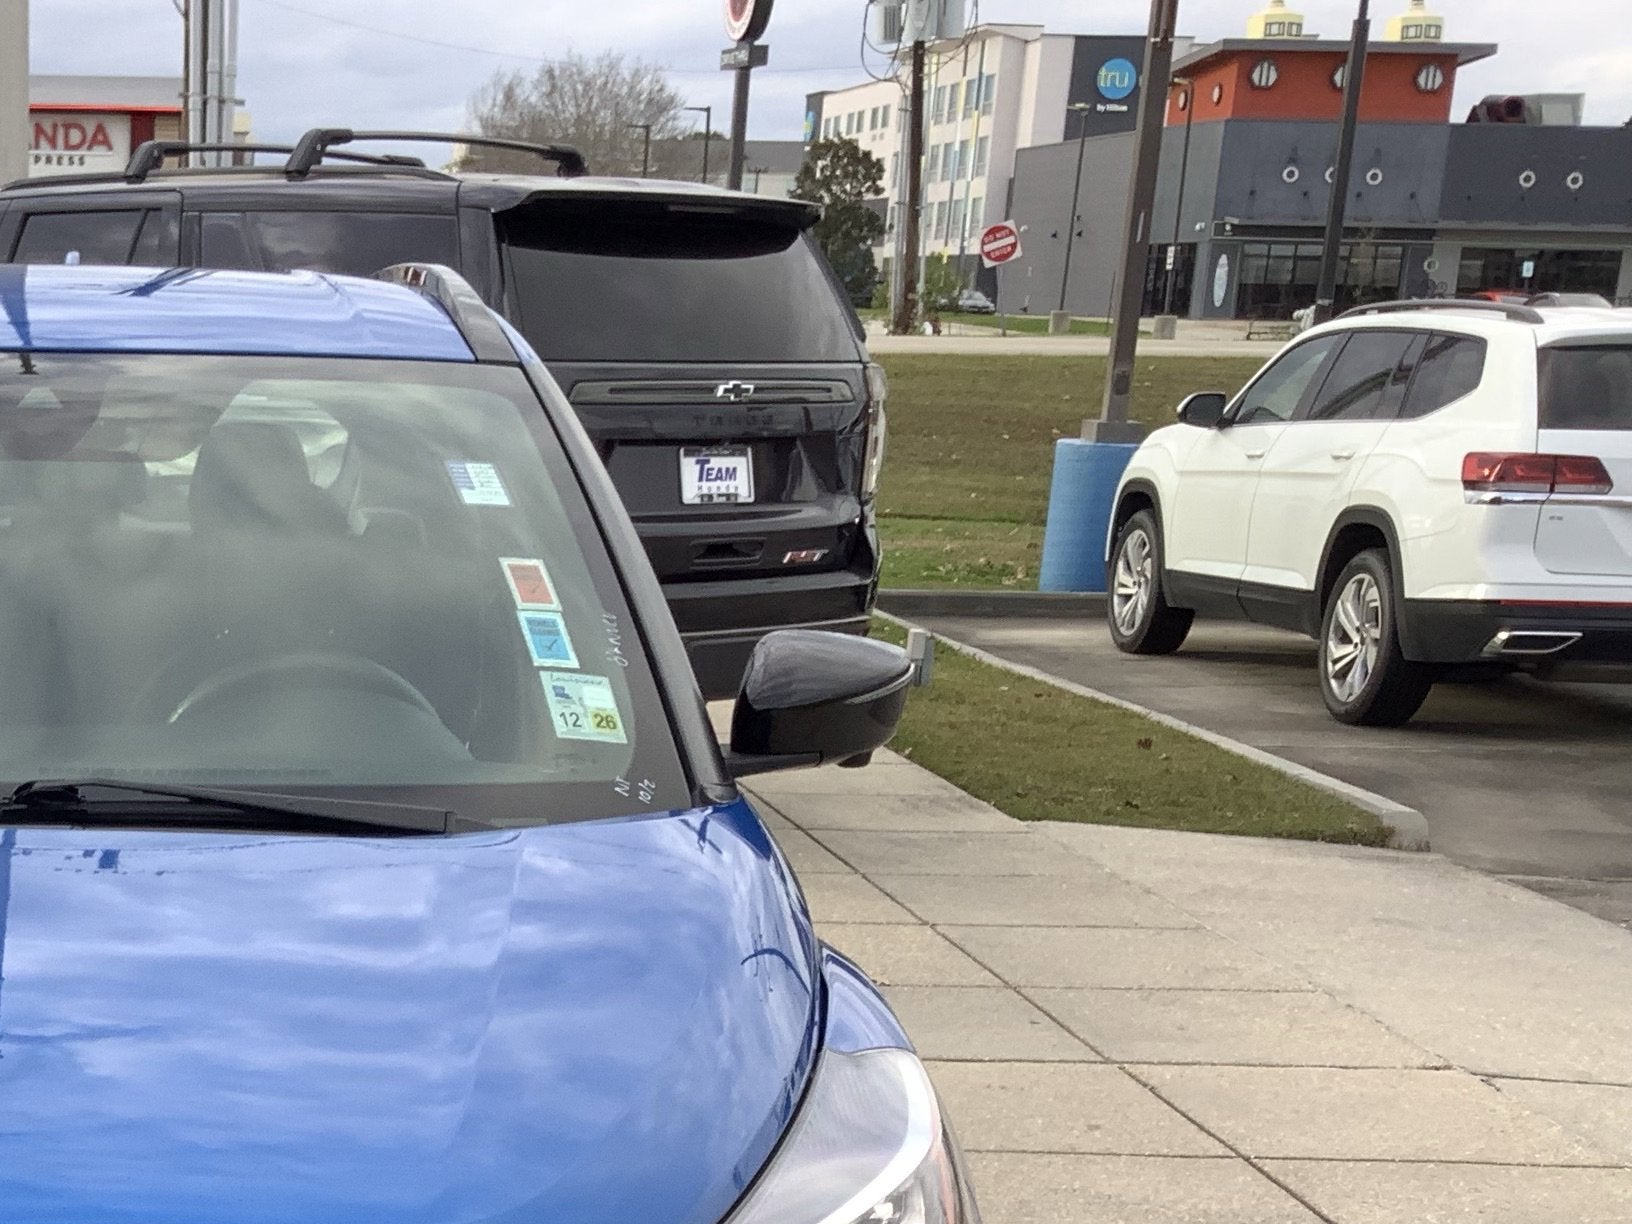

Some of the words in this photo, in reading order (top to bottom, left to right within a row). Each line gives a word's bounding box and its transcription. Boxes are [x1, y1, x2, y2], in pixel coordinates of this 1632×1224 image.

[1098, 66, 1129, 88] tru
[28, 121, 114, 152] NDA
[695, 458, 737, 483] TEAM
[559, 711, 582, 728] 12
[593, 713, 618, 730] 26
